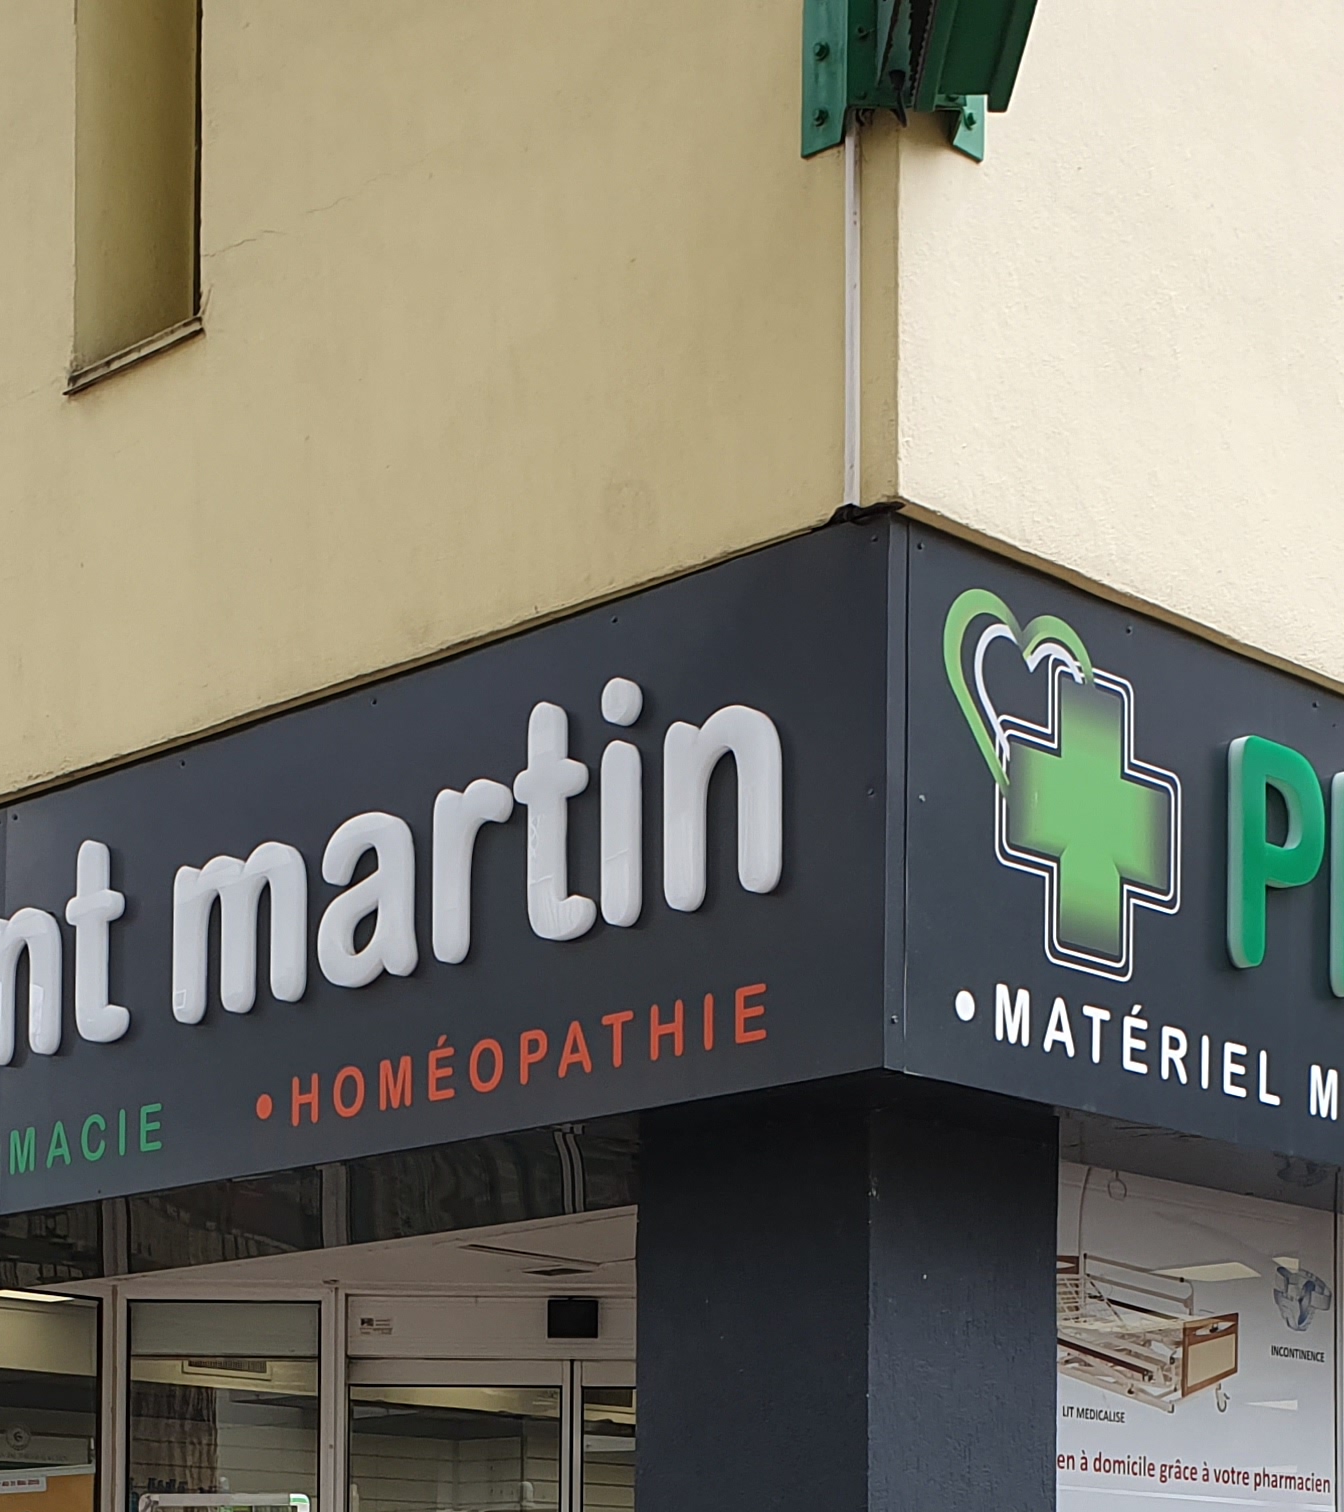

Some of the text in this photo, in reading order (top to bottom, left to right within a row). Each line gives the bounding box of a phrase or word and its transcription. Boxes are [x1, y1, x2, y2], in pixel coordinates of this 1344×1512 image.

[172, 676, 783, 1026] martin
[291, 983, 768, 1127] HOMÉOPATHIE
[994, 983, 1281, 1107] MATÉRIEL
[1270, 1344, 1325, 1362] INCONTINENCE
[1062, 1405, 1126, 1423] LIT MEDICALISE
[1057, 1449, 1331, 1494] en à domicile grâce à votre pharmacien
